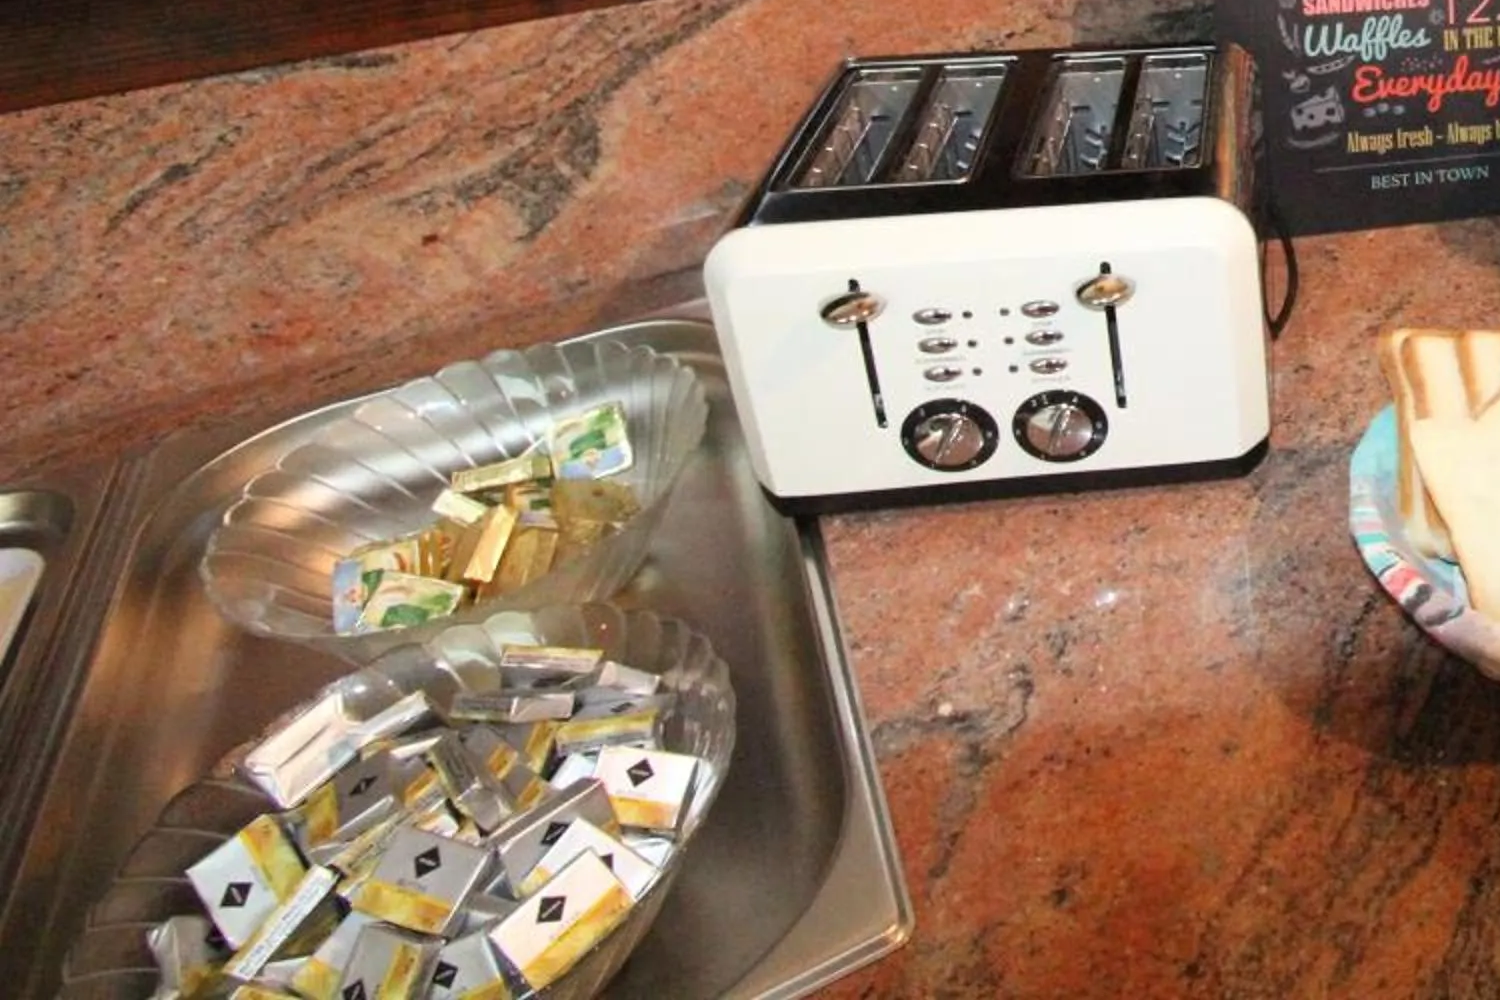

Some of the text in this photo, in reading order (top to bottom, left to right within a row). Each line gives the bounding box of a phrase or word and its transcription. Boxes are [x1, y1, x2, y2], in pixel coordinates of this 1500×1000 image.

[1303, 15, 1432, 62] Waffles
[1443, 28, 1460, 52] IN
[1464, 26, 1494, 50] THE
[1346, 129, 1393, 155] Always
[1396, 125, 1434, 150] fresh
[1447, 120, 1493, 145] Always
[1370, 165, 1490, 190] BEST IN TOWN
